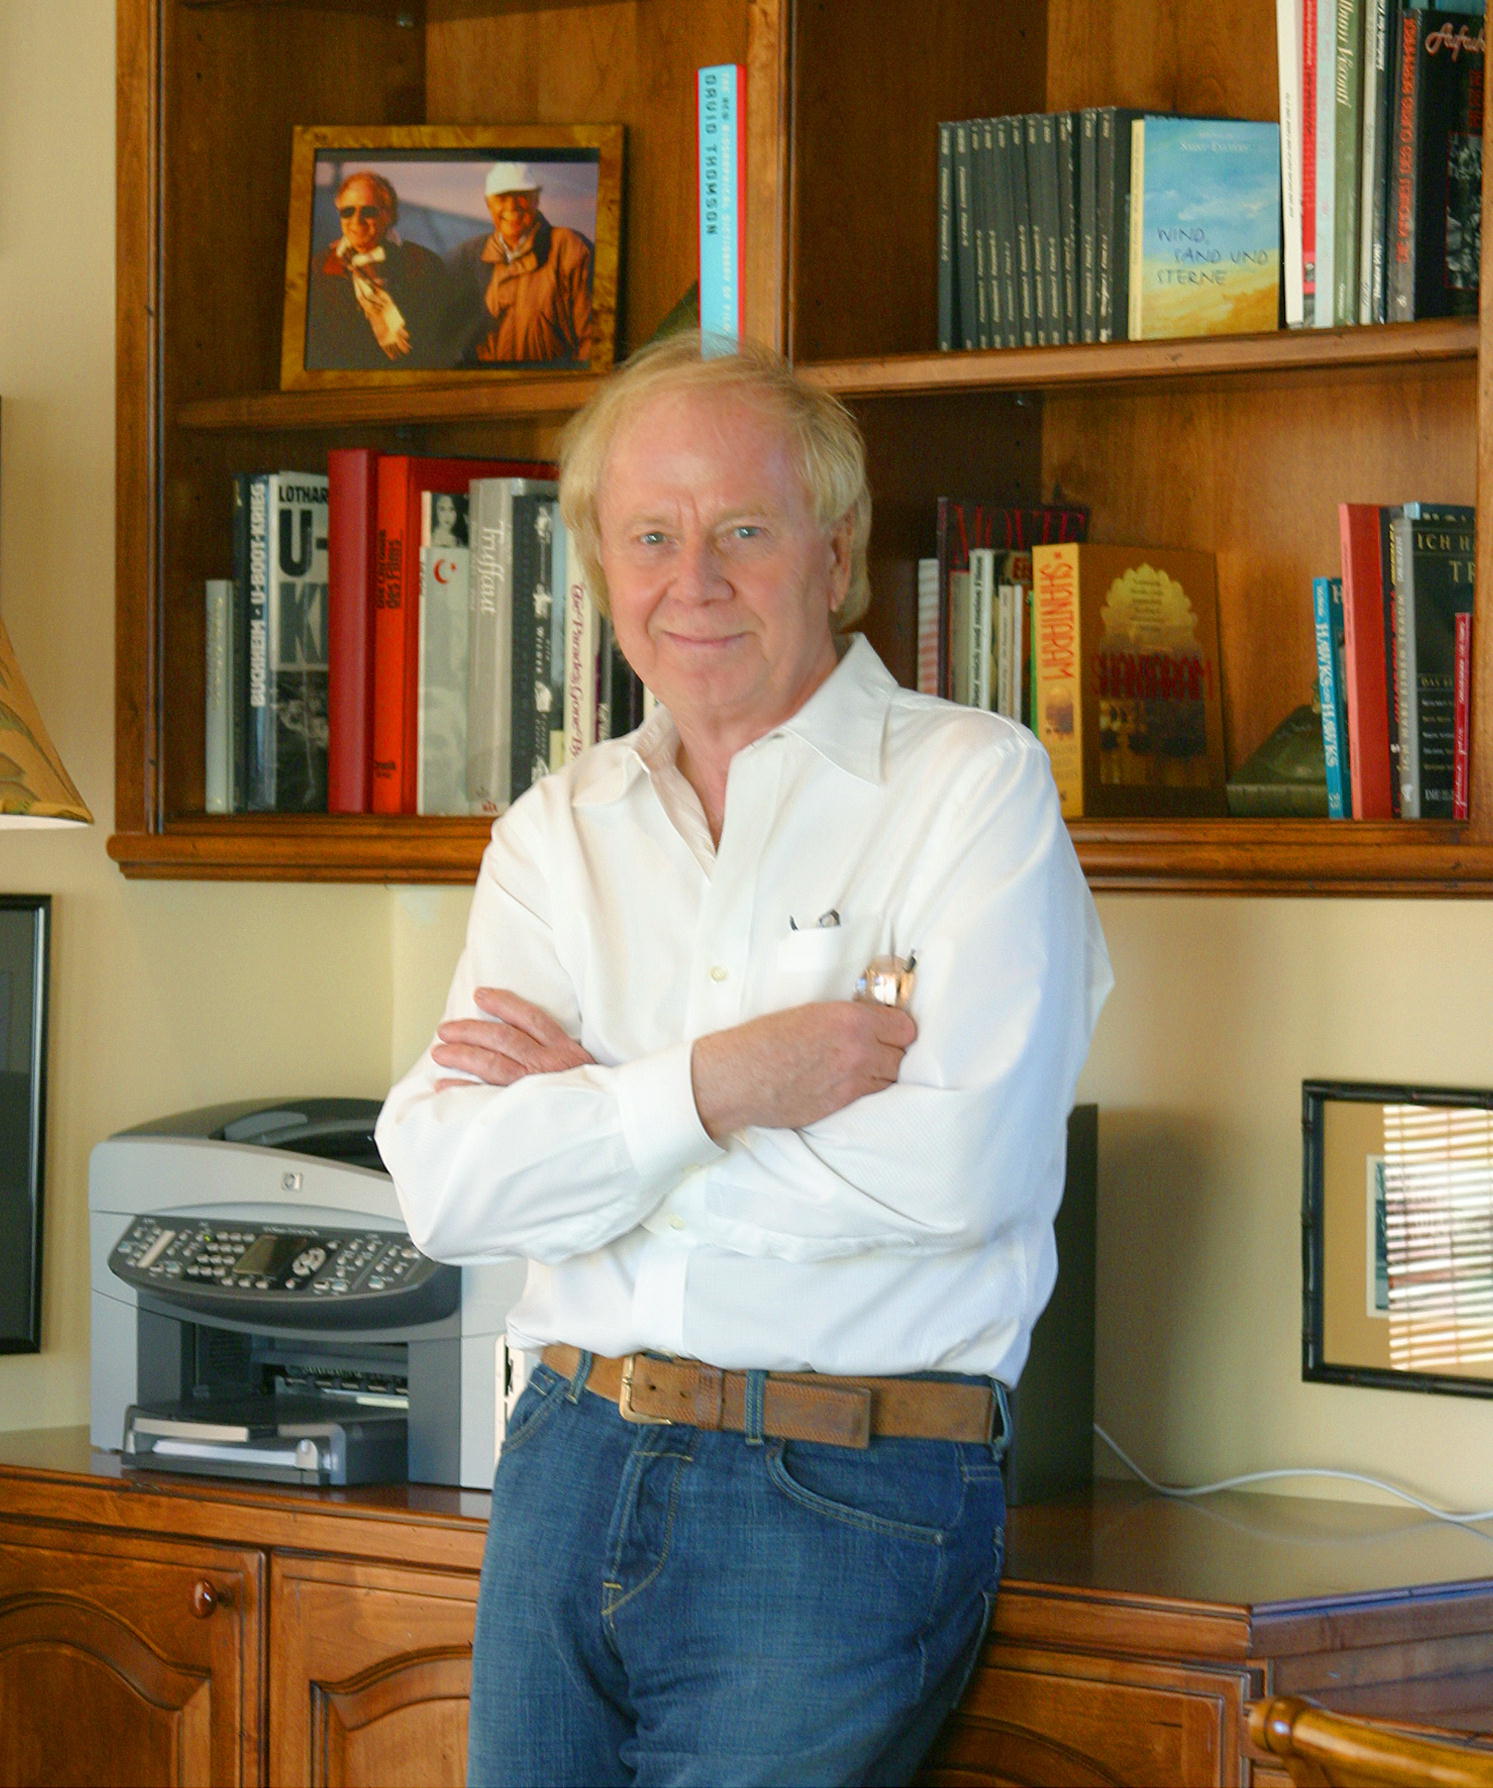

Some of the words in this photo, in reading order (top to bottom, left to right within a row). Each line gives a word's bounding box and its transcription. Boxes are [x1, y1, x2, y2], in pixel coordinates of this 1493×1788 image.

[1336, 0, 1354, 44] lbum
[1335, 47, 1354, 109] Visconti
[704, 73, 718, 135] DAVID
[704, 145, 719, 237] THOMSON
[1156, 269, 1228, 286] STERNE
[1174, 248, 1222, 264] SAND
[1229, 249, 1269, 265] UND
[278, 485, 329, 503] LOTHAR
[250, 483, 266, 604] U-BOOT-KRIEG
[386, 539, 401, 580] Films
[1416, 532, 1451, 551] ICH
[1459, 535, 1475, 552] H
[478, 520, 505, 615] Truffaut
[571, 584, 584, 616] The
[1040, 562, 1076, 682] SHANTARAM
[1398, 594, 1408, 643] TRAUM
[250, 620, 266, 707] BUCHHEIM
[1316, 622, 1335, 688] HAWKS
[1398, 649, 1409, 695] EINEN
[570, 685, 584, 735] Gone
[1399, 702, 1410, 738] HABE
[1321, 702, 1339, 768] HAWKS
